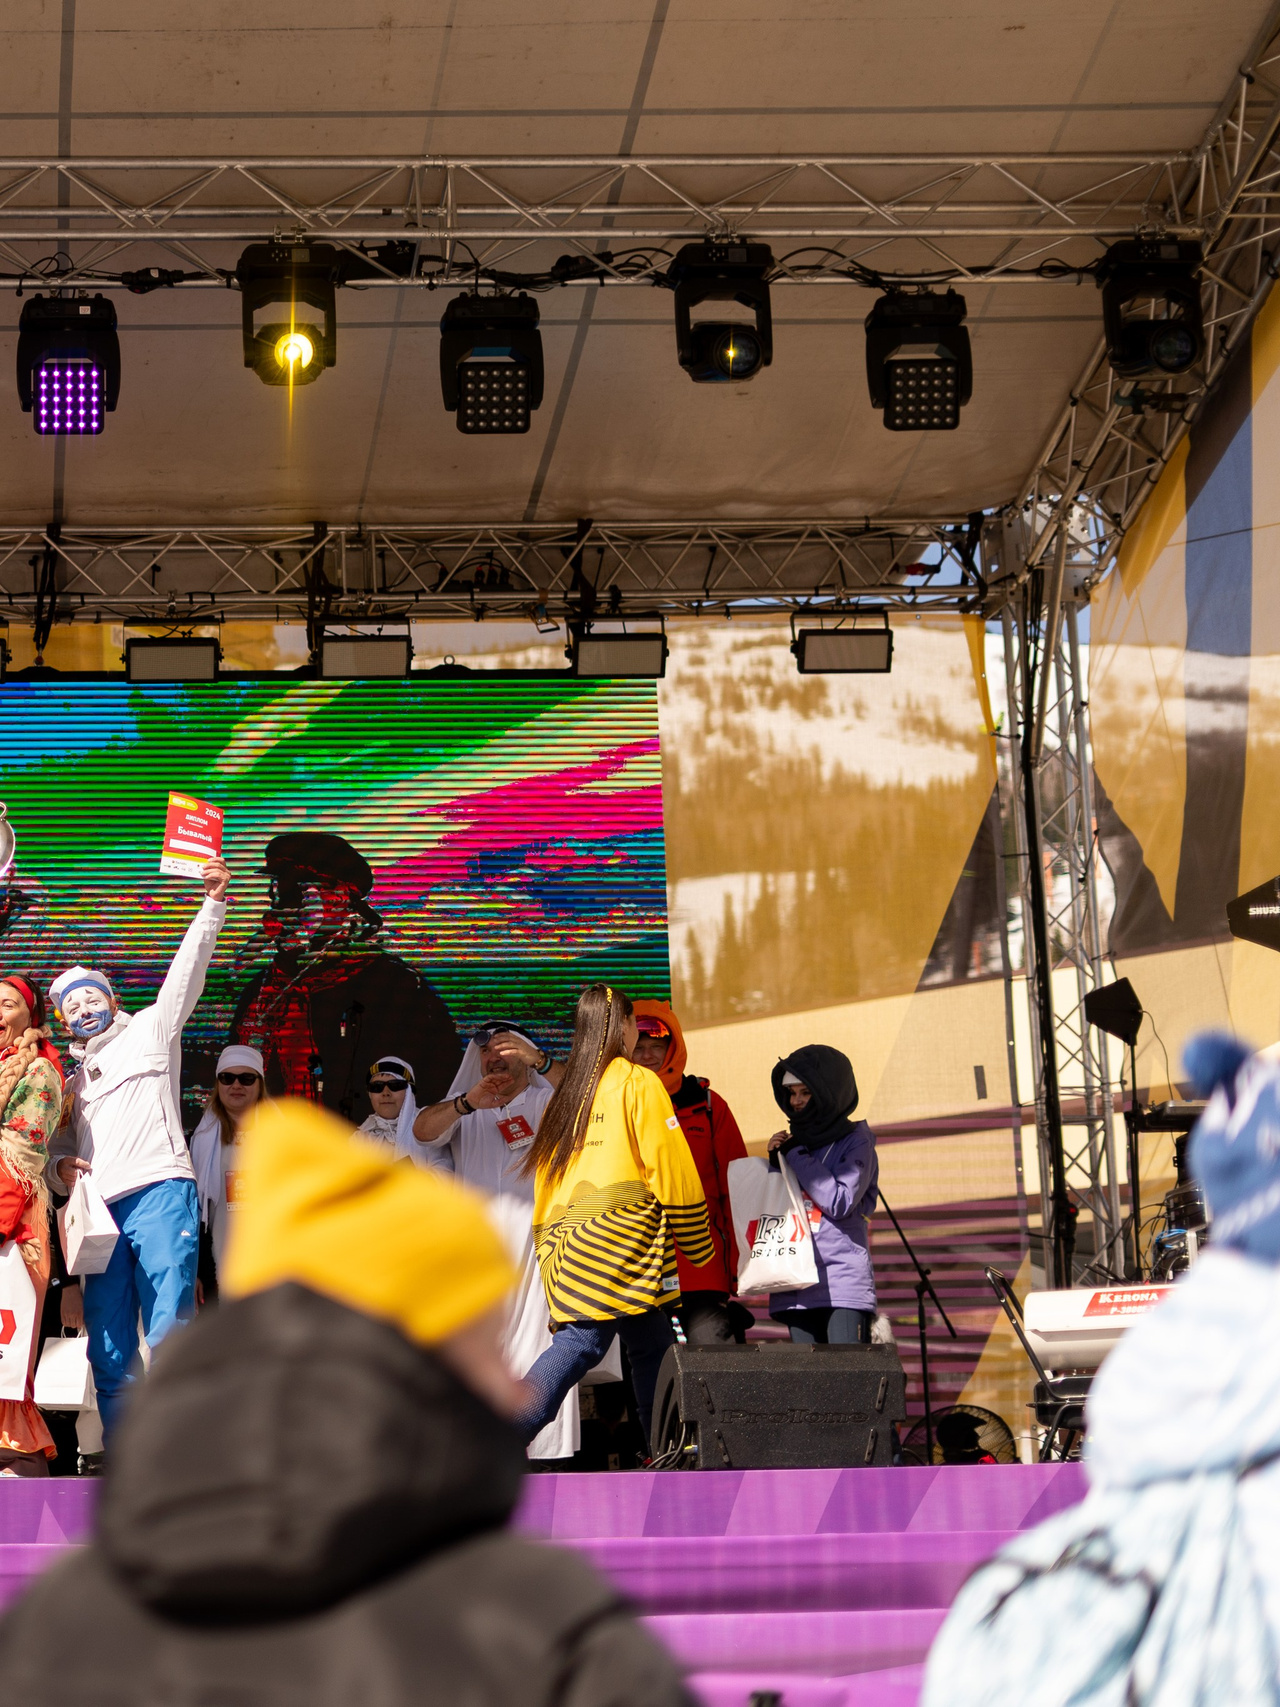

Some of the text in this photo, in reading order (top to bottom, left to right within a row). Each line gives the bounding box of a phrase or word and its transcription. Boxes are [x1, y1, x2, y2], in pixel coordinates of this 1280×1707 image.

[205, 808, 221, 820] 2024
[177, 826, 213, 843] Бывалый
[512, 1131, 526, 1139] 120
[721, 1408, 869, 1424] ProTone
